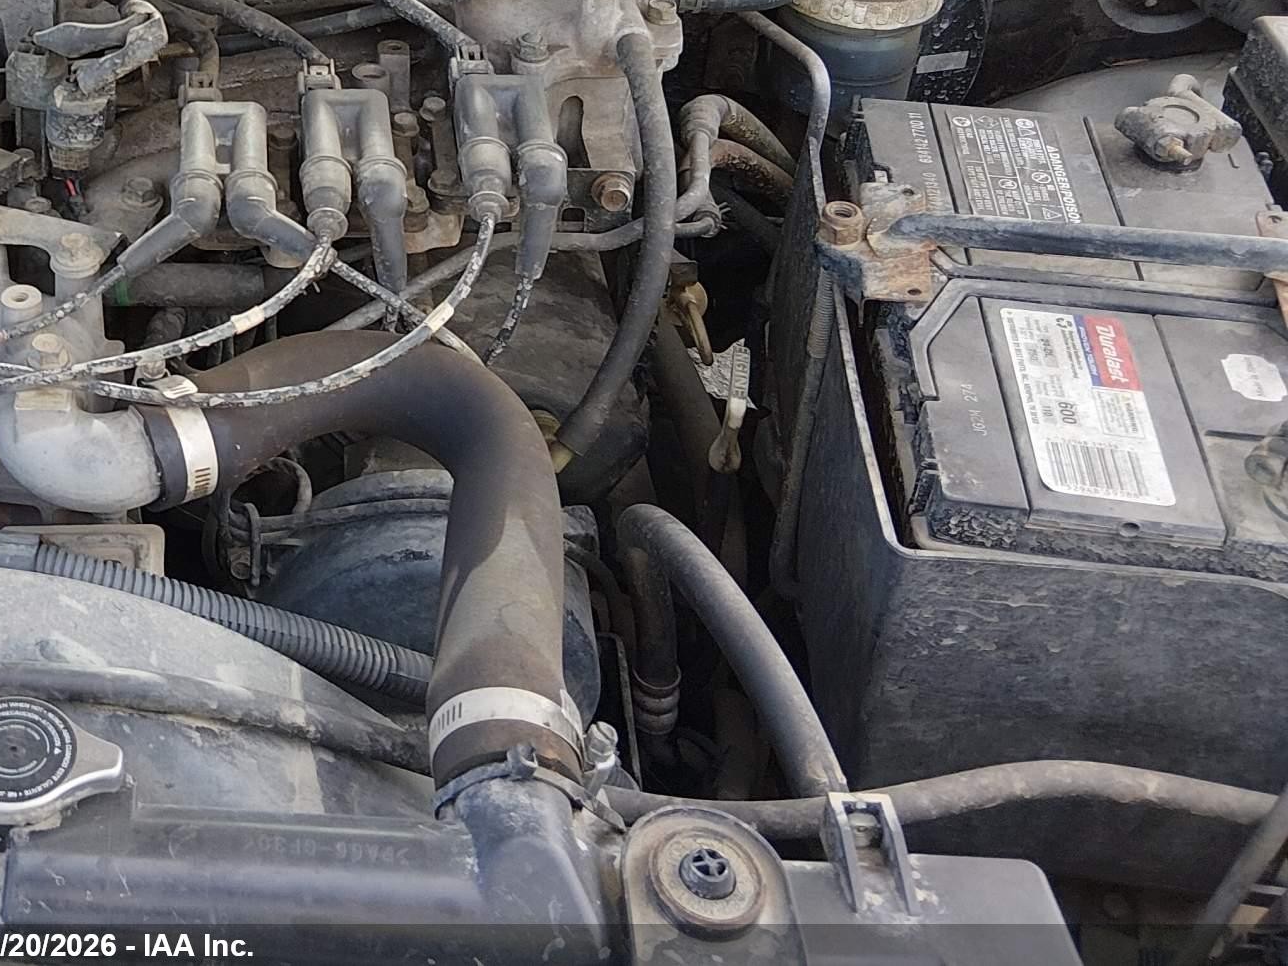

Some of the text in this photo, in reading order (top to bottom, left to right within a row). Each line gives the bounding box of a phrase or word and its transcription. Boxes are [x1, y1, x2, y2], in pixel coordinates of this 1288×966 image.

[732, 345, 749, 399] ENGINE
[1096, 325, 1129, 383] Duralast
[963, 383, 988, 436] JG2M 274
[1058, 401, 1078, 425] 600
